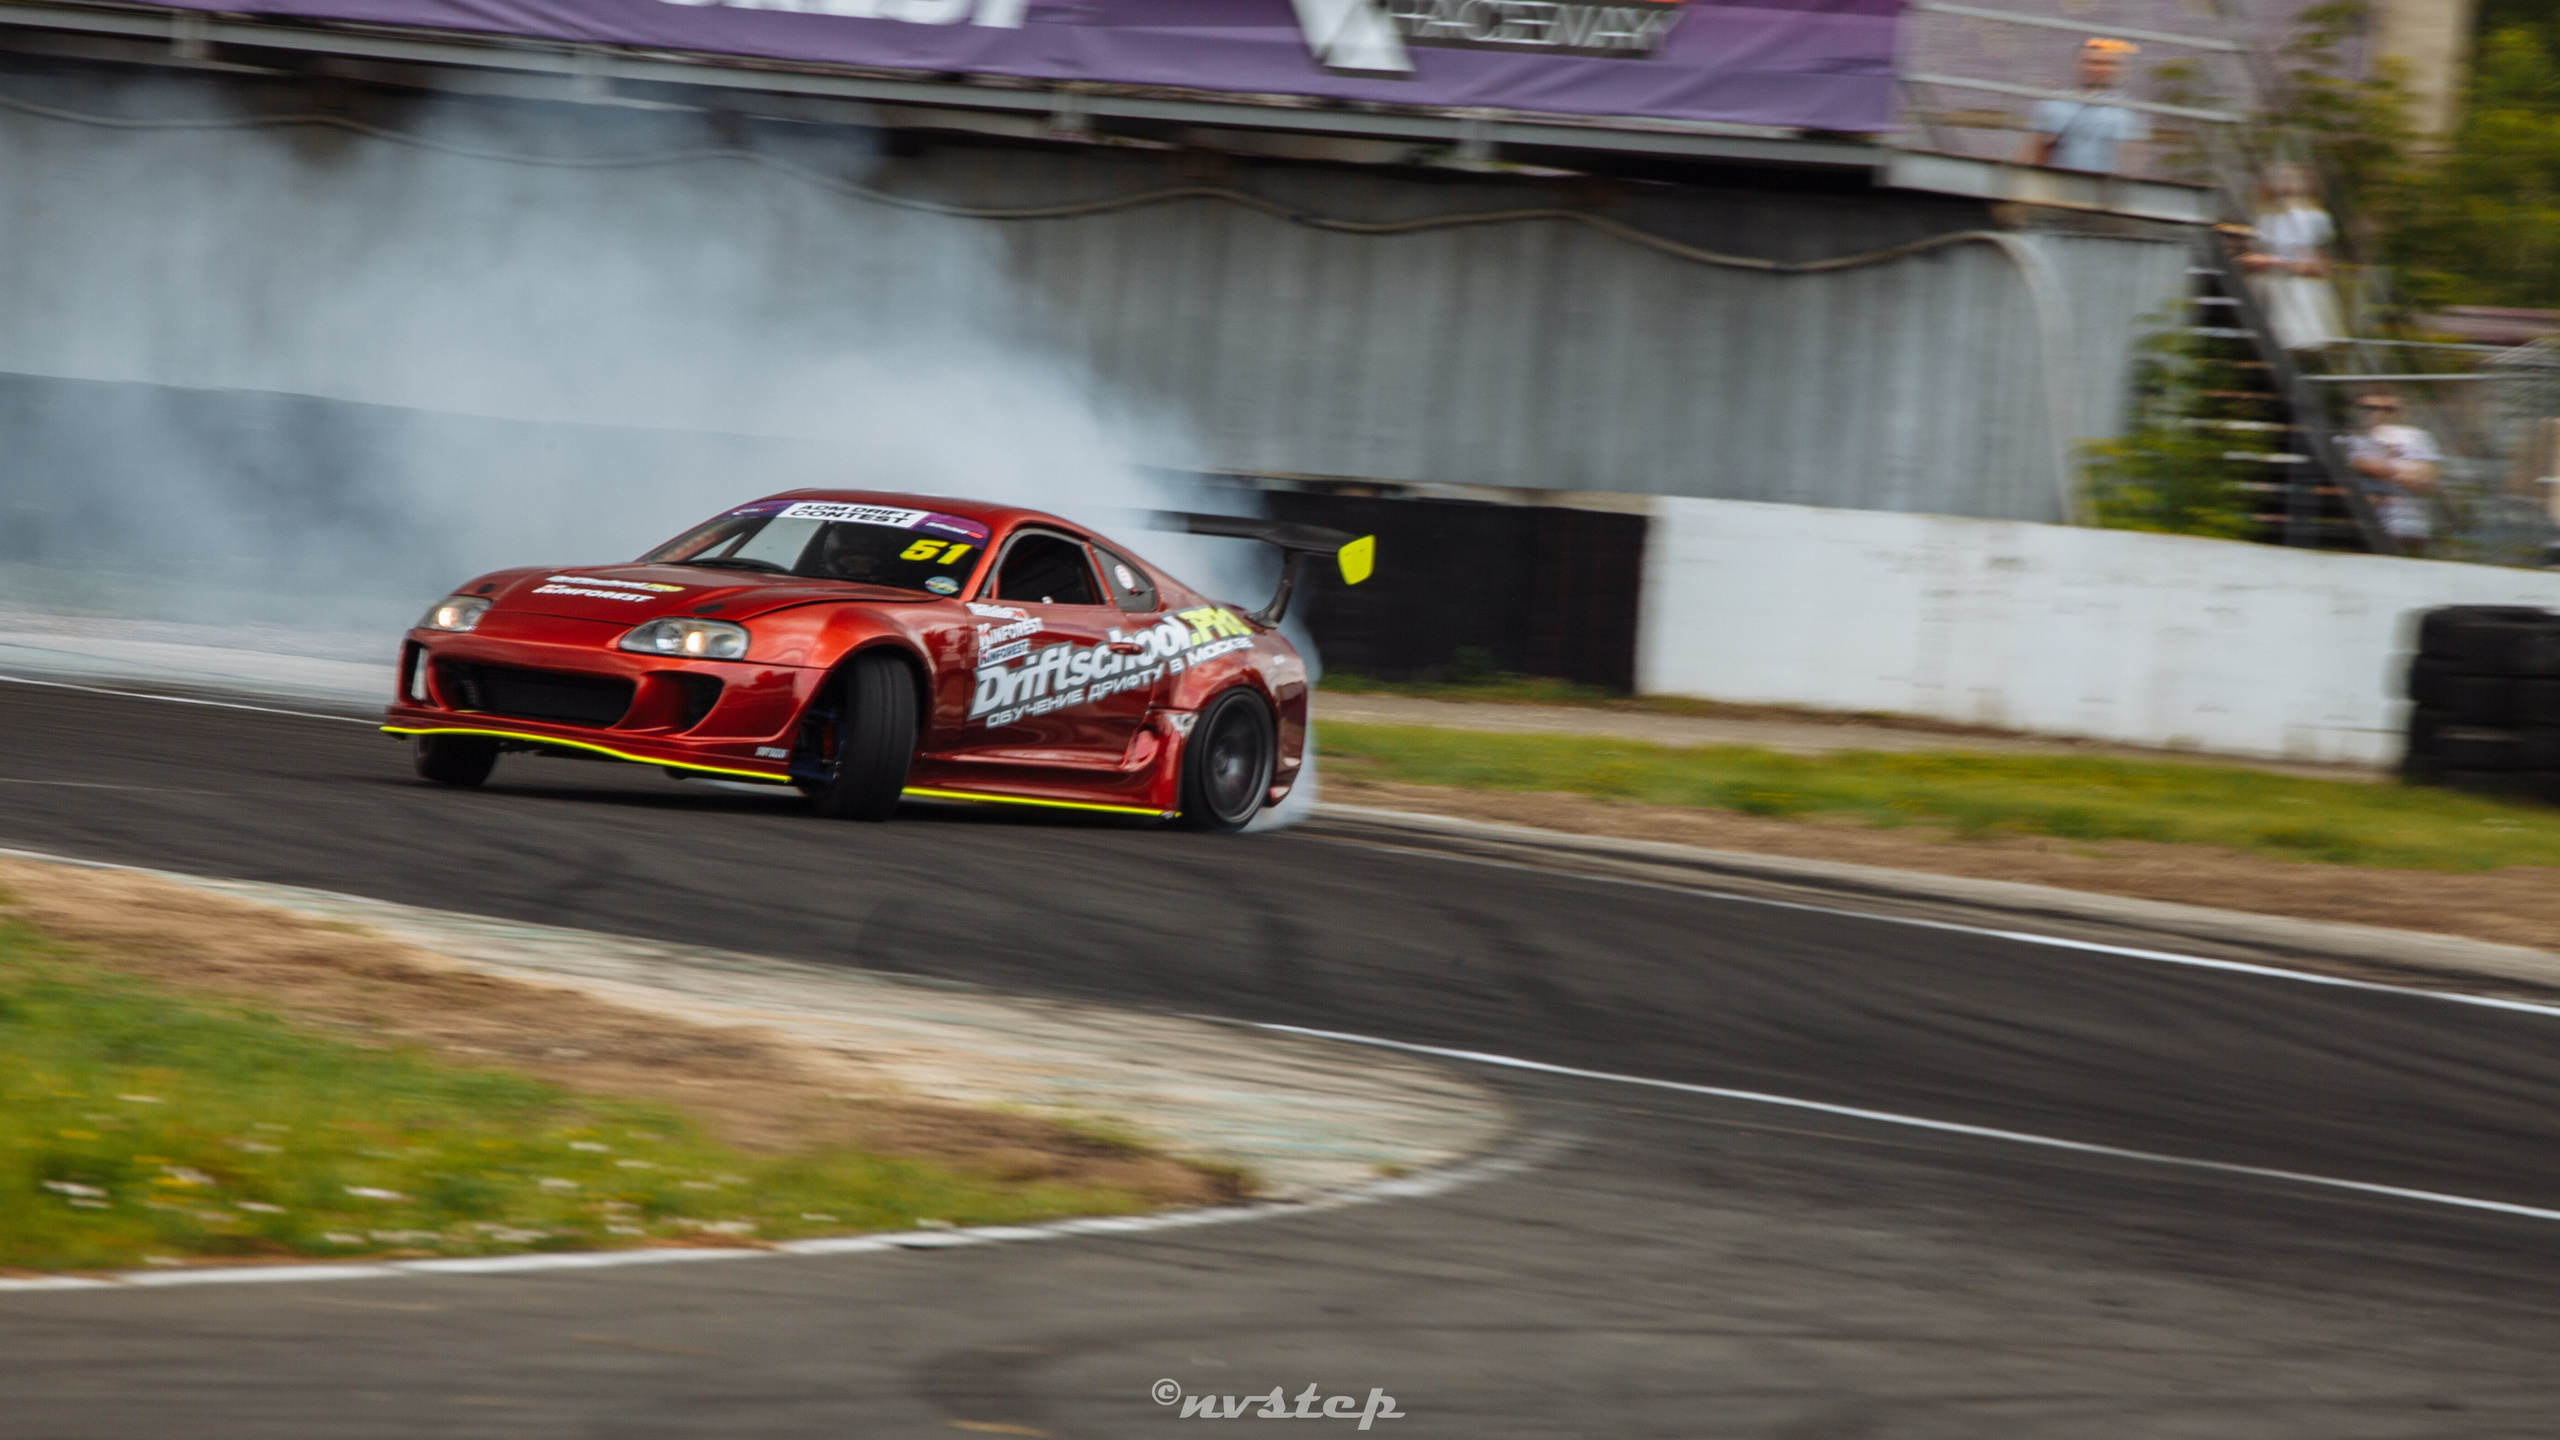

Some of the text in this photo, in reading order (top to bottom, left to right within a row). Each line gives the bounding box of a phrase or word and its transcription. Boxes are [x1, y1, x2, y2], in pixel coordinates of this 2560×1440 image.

[791, 510, 909, 524] CONTEST
[851, 506, 915, 517] DRIFT
[900, 539, 972, 565] 51
[985, 688, 1085, 729] ОБУЧЕНИЕ
[1086, 663, 1165, 702] ДРИФТУ
[1169, 657, 1185, 676] В
